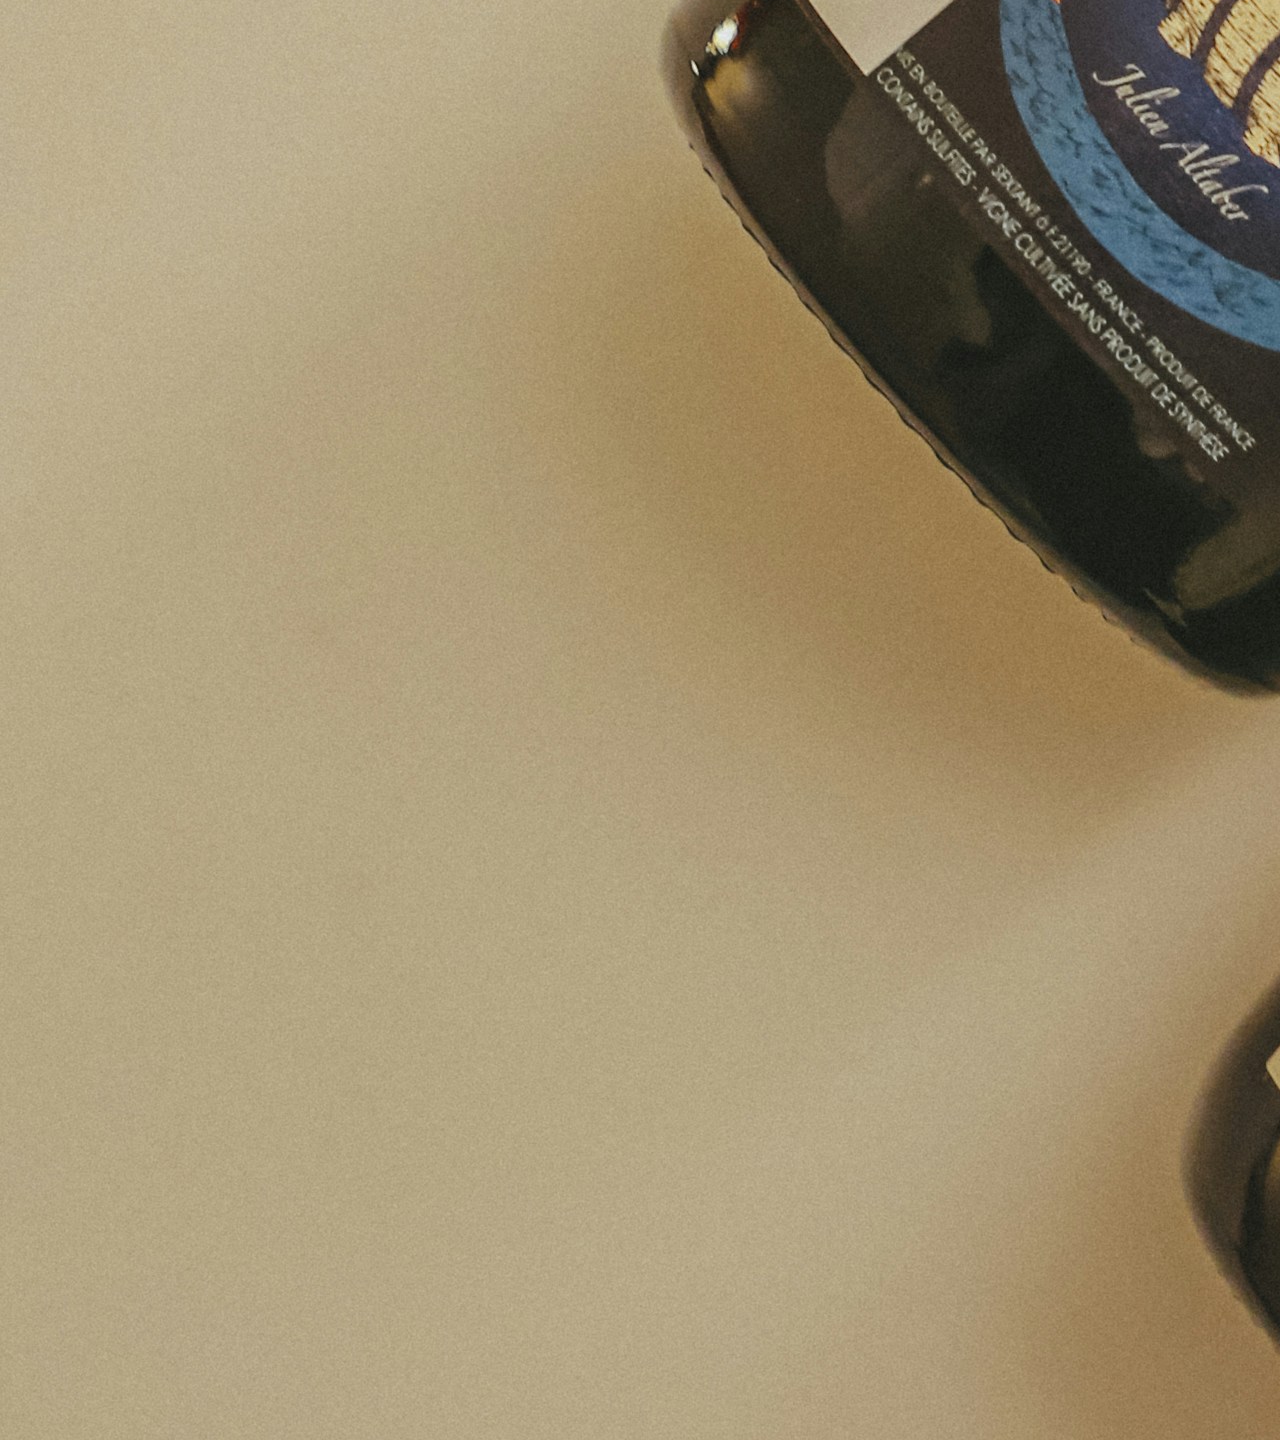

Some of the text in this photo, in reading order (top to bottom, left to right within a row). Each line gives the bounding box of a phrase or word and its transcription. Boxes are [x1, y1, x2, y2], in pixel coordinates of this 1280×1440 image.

[876, 66, 936, 136] CONTAINS
[925, 128, 978, 187] SULFITES
[978, 186, 1023, 239] VIGNE
[1067, 292, 1108, 335] SANS
[1099, 327, 1159, 388] PRODUIT
[1149, 382, 1177, 409] DE
[908, 61, 923, 85] EN
[921, 79, 975, 144] BOUTEILLE
[969, 136, 997, 168] PAR
[990, 162, 1042, 220] SEXTANT
[1092, 277, 1145, 335] FRANCE
[1144, 335, 1199, 391] PRODUIT
[1190, 385, 1215, 409] DE
[1208, 402, 1257, 452] FRANCE
[1092, 62, 1269, 221] Julien Altaber
